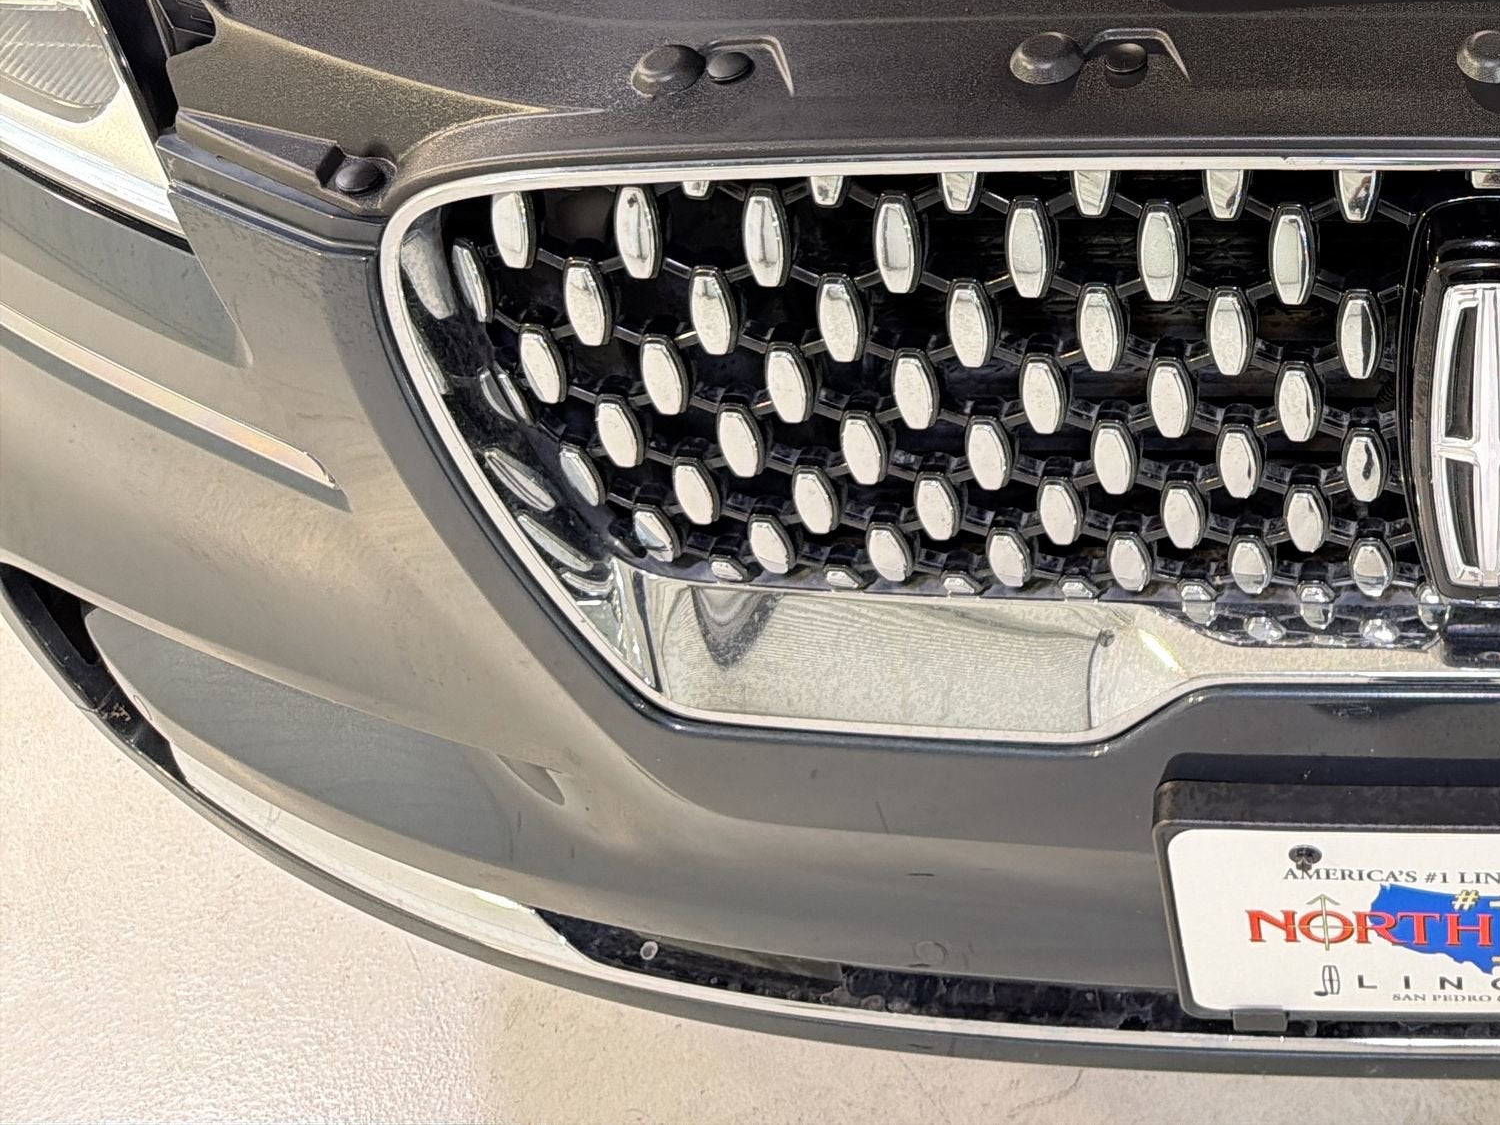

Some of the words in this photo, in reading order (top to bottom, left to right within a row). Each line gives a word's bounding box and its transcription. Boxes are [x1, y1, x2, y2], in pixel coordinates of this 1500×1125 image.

[1283, 868, 1418, 884] AMERICA'S
[1425, 872, 1450, 884] #1
[1245, 909, 1492, 947] NORTH
[1392, 993, 1427, 1002] SAN
[1432, 993, 1492, 1002] PEDRO
